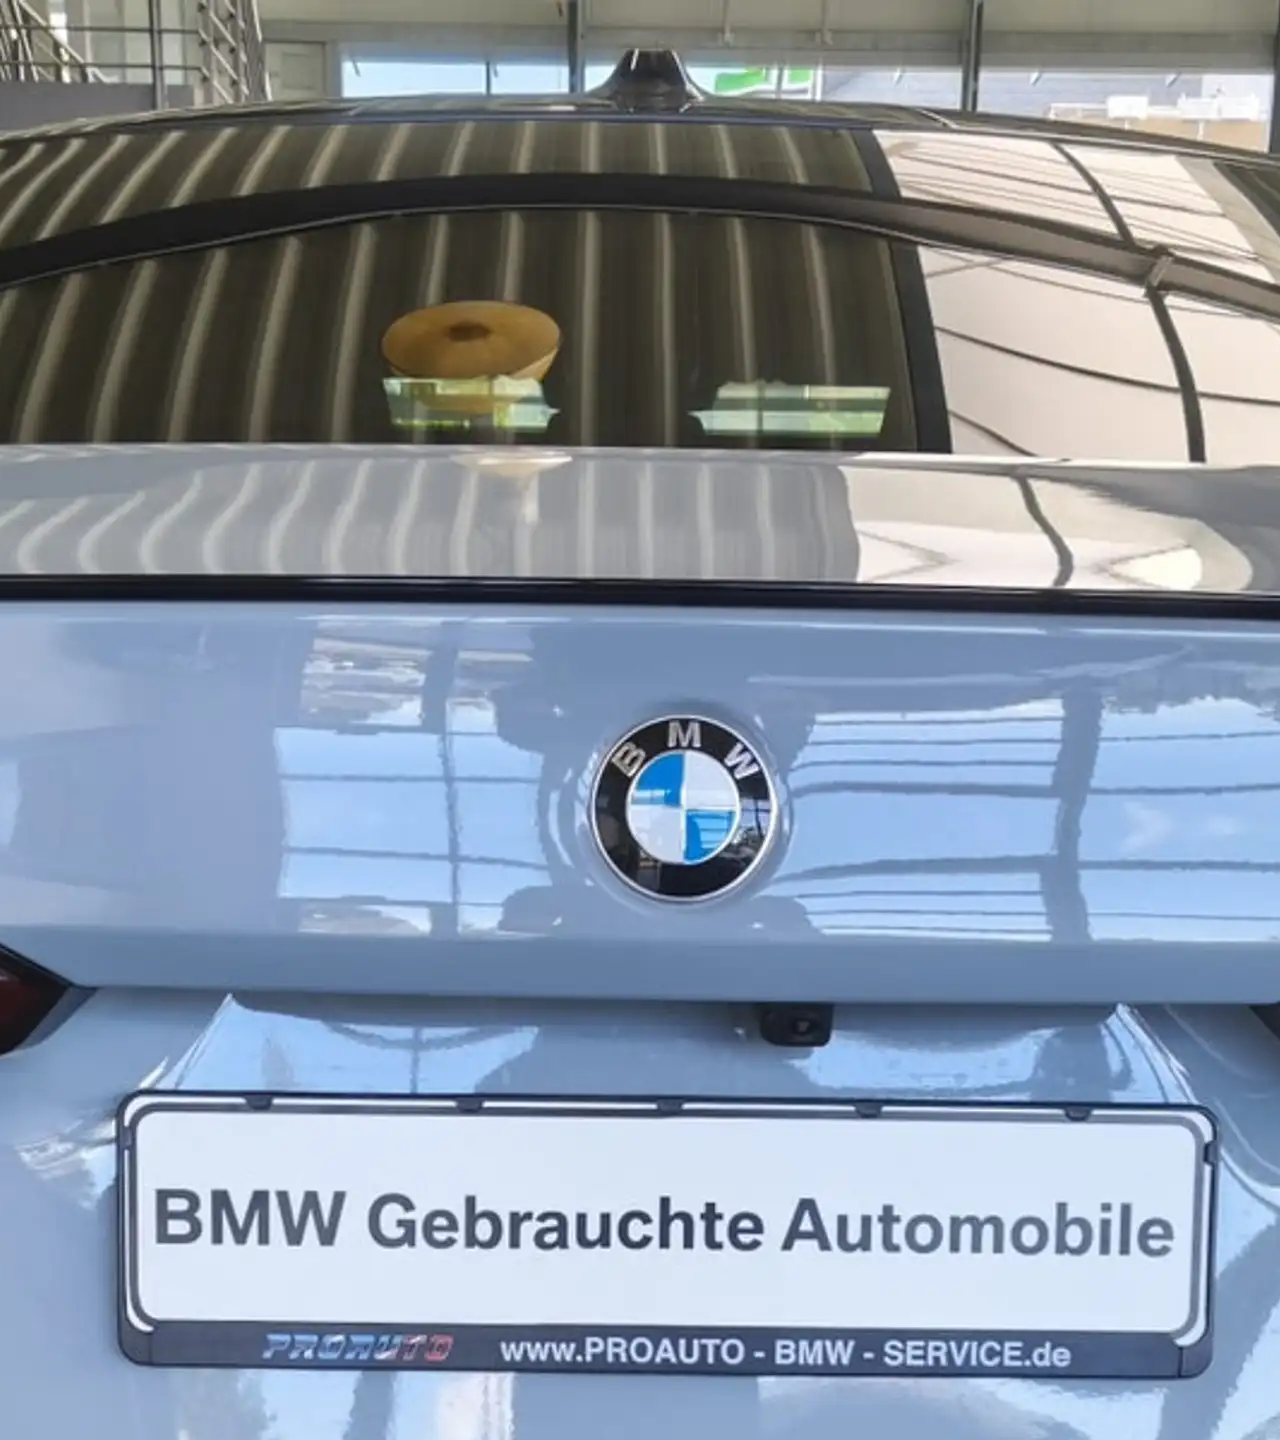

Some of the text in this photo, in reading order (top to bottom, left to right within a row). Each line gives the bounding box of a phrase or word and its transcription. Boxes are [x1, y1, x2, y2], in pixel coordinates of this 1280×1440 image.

[610, 719, 760, 779] BMW
[154, 1188, 1175, 1258] BMW Gebrauchte Automobile
[261, 1334, 454, 1362] PROAUTO
[774, 1339, 856, 1366] BMW
[882, 1340, 1071, 1367] SERVICE.de
